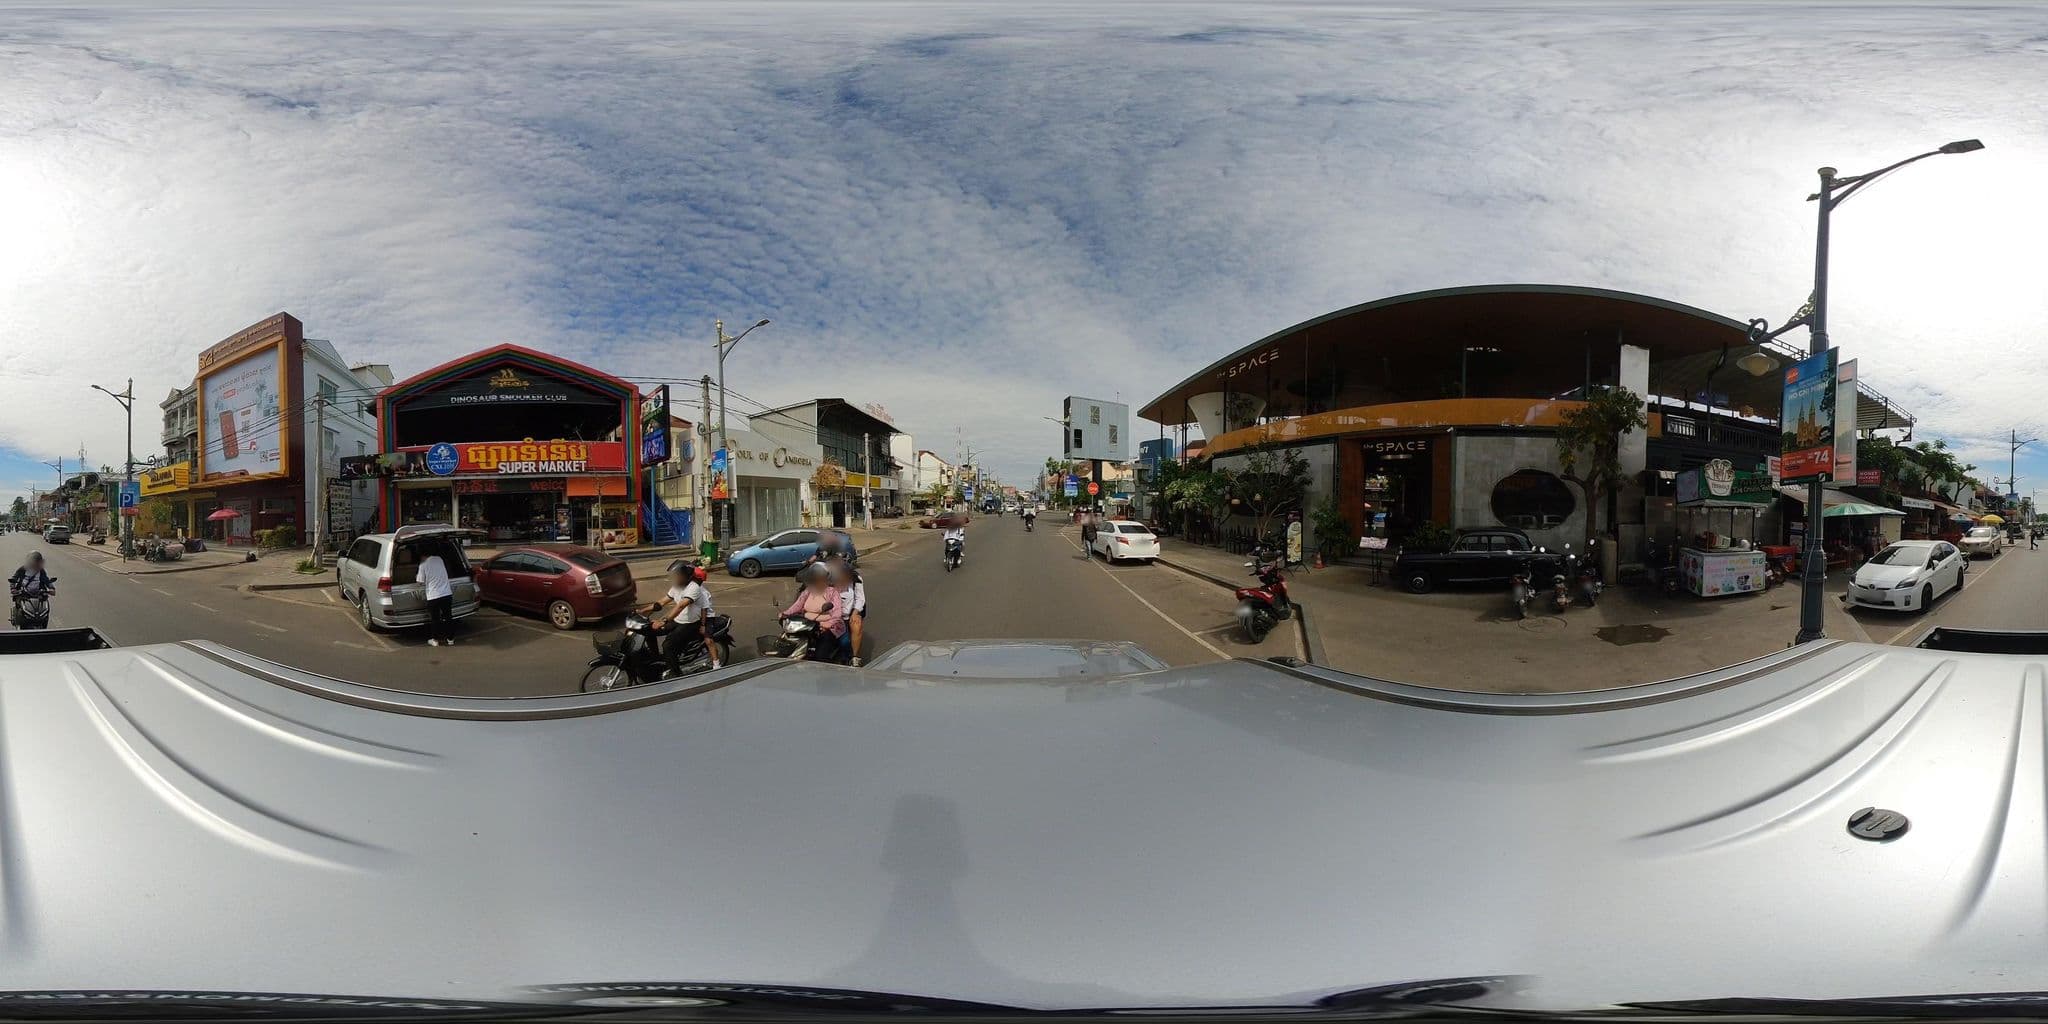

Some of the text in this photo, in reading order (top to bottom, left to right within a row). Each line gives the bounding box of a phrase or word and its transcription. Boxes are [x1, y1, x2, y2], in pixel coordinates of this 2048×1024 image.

[1228, 348, 1280, 378] SPACE
[450, 395, 498, 404] DINOSAUR
[499, 394, 543, 402] SNOOKER
[1376, 441, 1426, 452] SPACE
[759, 451, 769, 462] OF
[773, 447, 812, 468] CAMBODIA
[1814, 450, 1829, 464] 74
[498, 460, 588, 474] SUPER MARKET
[122, 494, 131, 507] P
